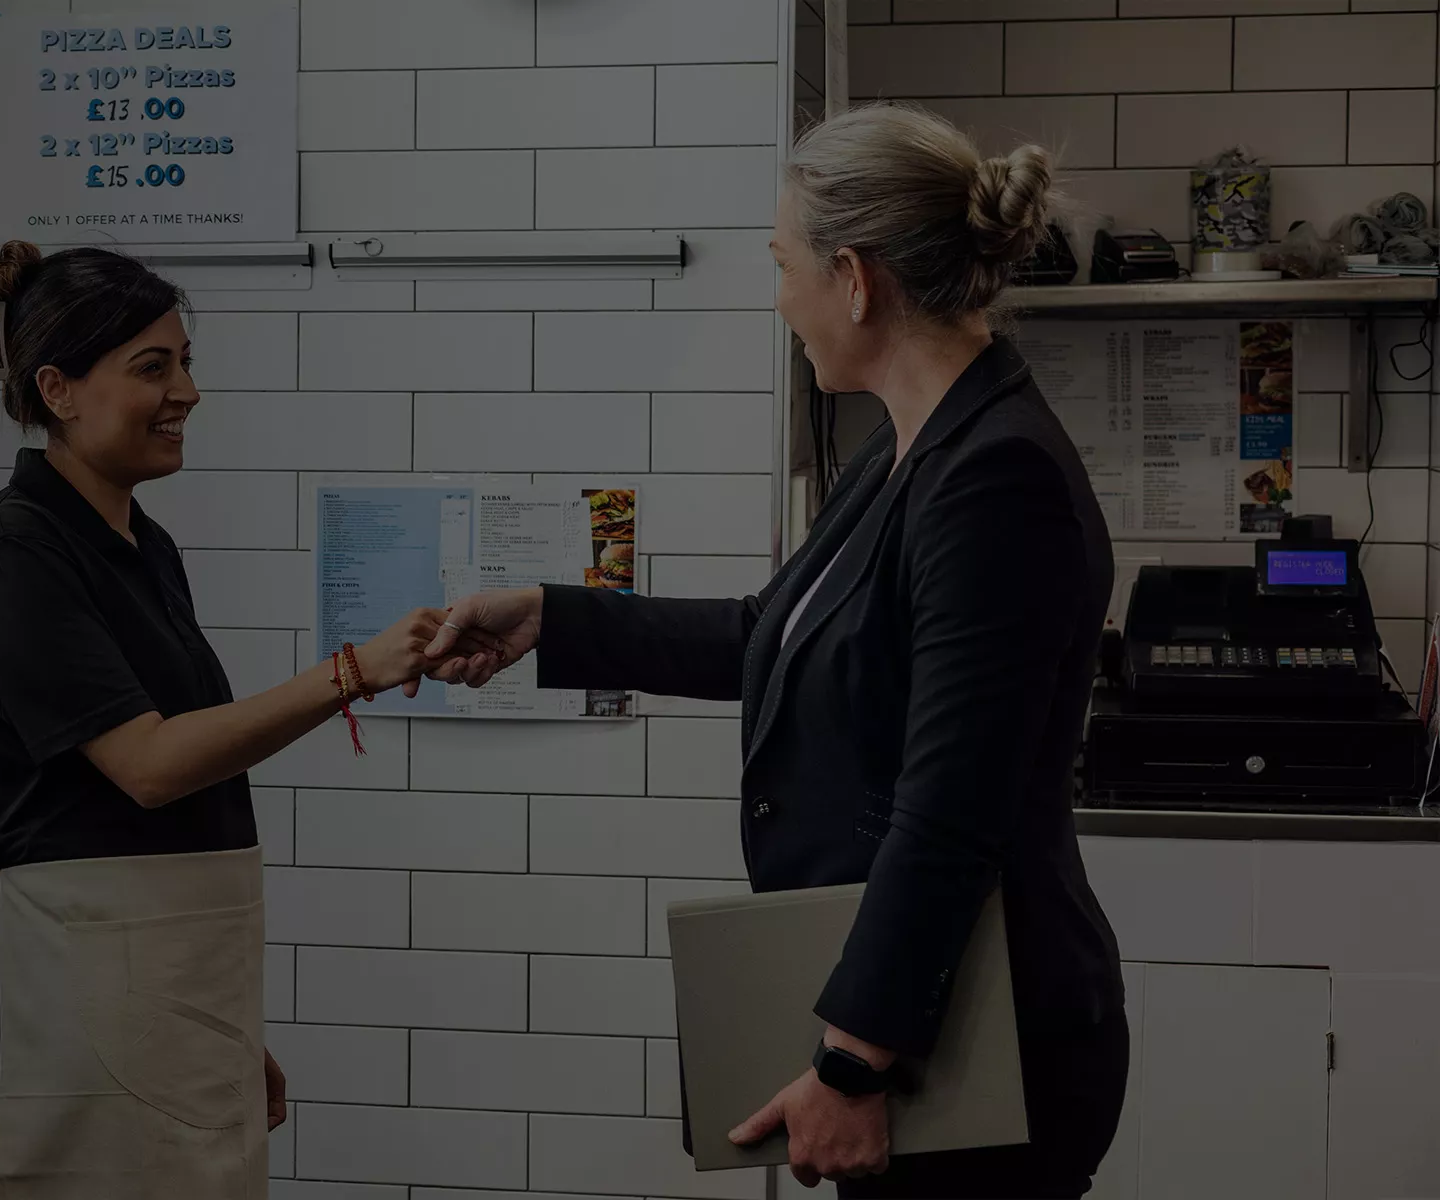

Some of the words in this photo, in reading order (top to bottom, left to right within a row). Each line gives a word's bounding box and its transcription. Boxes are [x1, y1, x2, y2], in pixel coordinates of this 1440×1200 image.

[41, 28, 127, 53] PIZZA
[134, 25, 232, 50] DEALS
[39, 69, 56, 91] 2
[63, 73, 80, 91] x
[145, 64, 236, 89] Pizzas
[39, 135, 57, 157] 2
[64, 139, 80, 157] x
[143, 131, 234, 155] Pizzas
[28, 215, 61, 226] ONLY
[65, 215, 70, 226] 1
[76, 215, 116, 225] OFFER
[120, 215, 136, 225] AT
[139, 214, 148, 225] A
[152, 214, 183, 225] TIME
[187, 213, 244, 225] THANKS!
